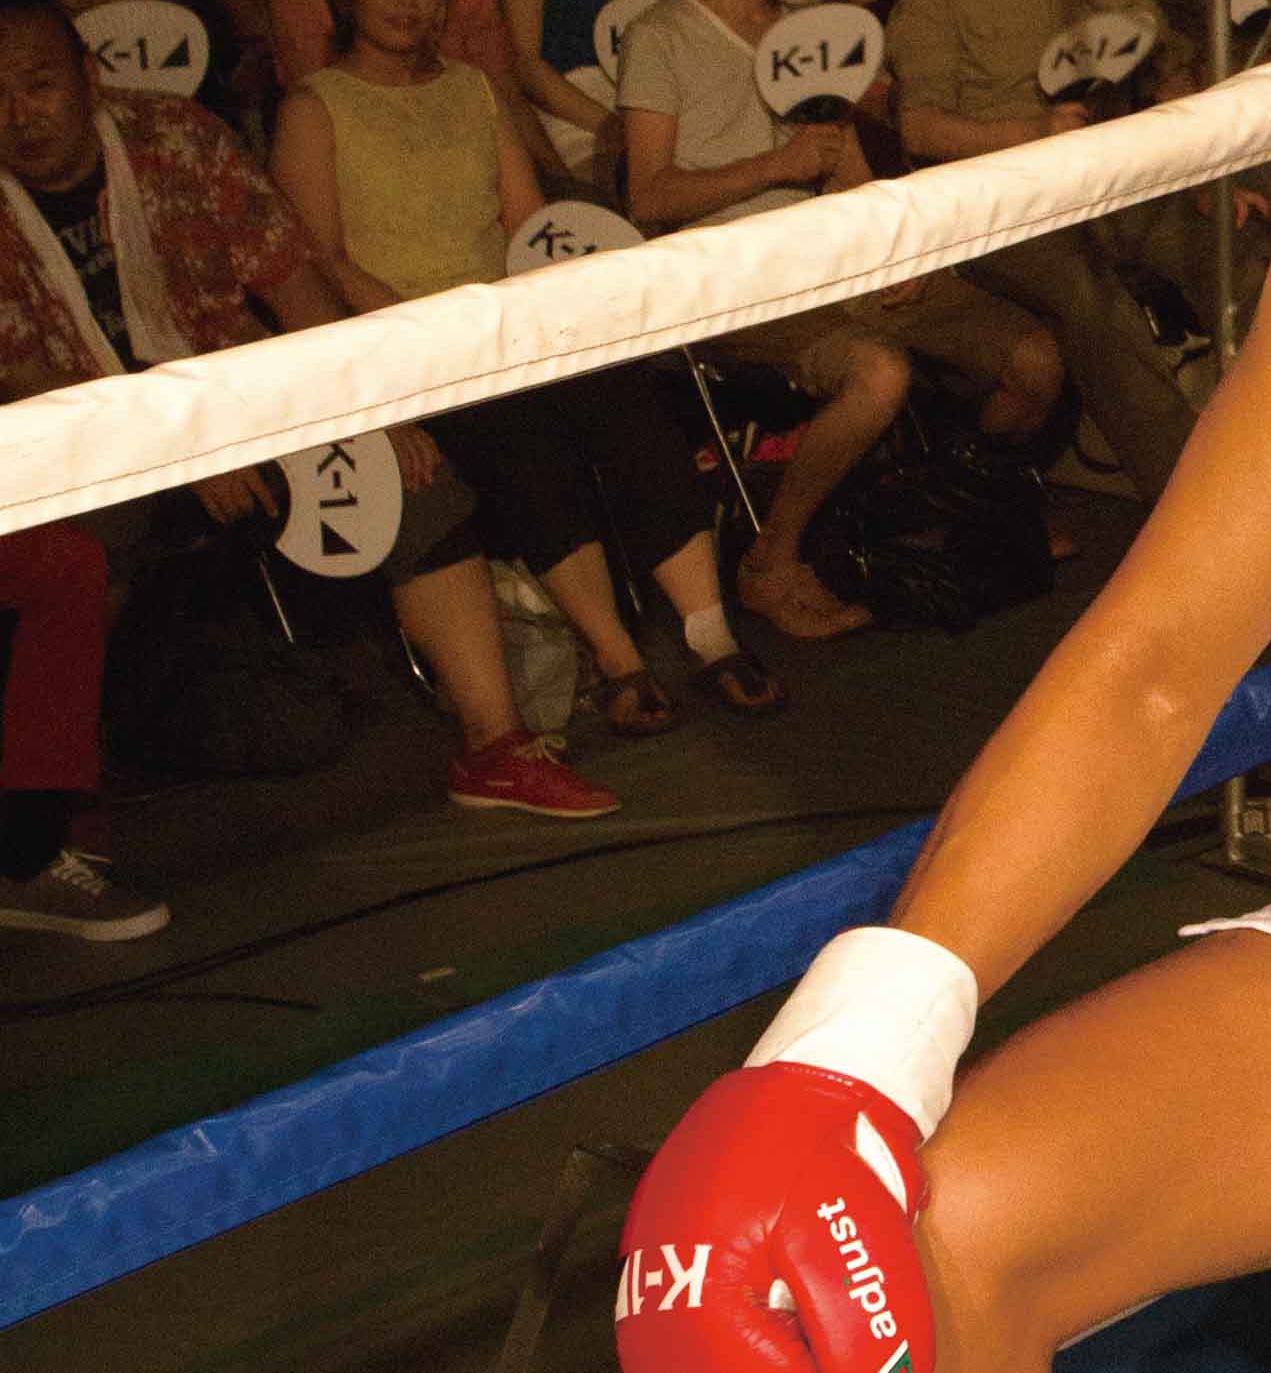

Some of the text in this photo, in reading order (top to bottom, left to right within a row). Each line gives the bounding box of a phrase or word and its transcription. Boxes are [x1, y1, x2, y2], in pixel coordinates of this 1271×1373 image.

[772, 39, 829, 82] K-1
[633, 1243, 713, 1317] K-1
[816, 1196, 898, 1341] adjust
